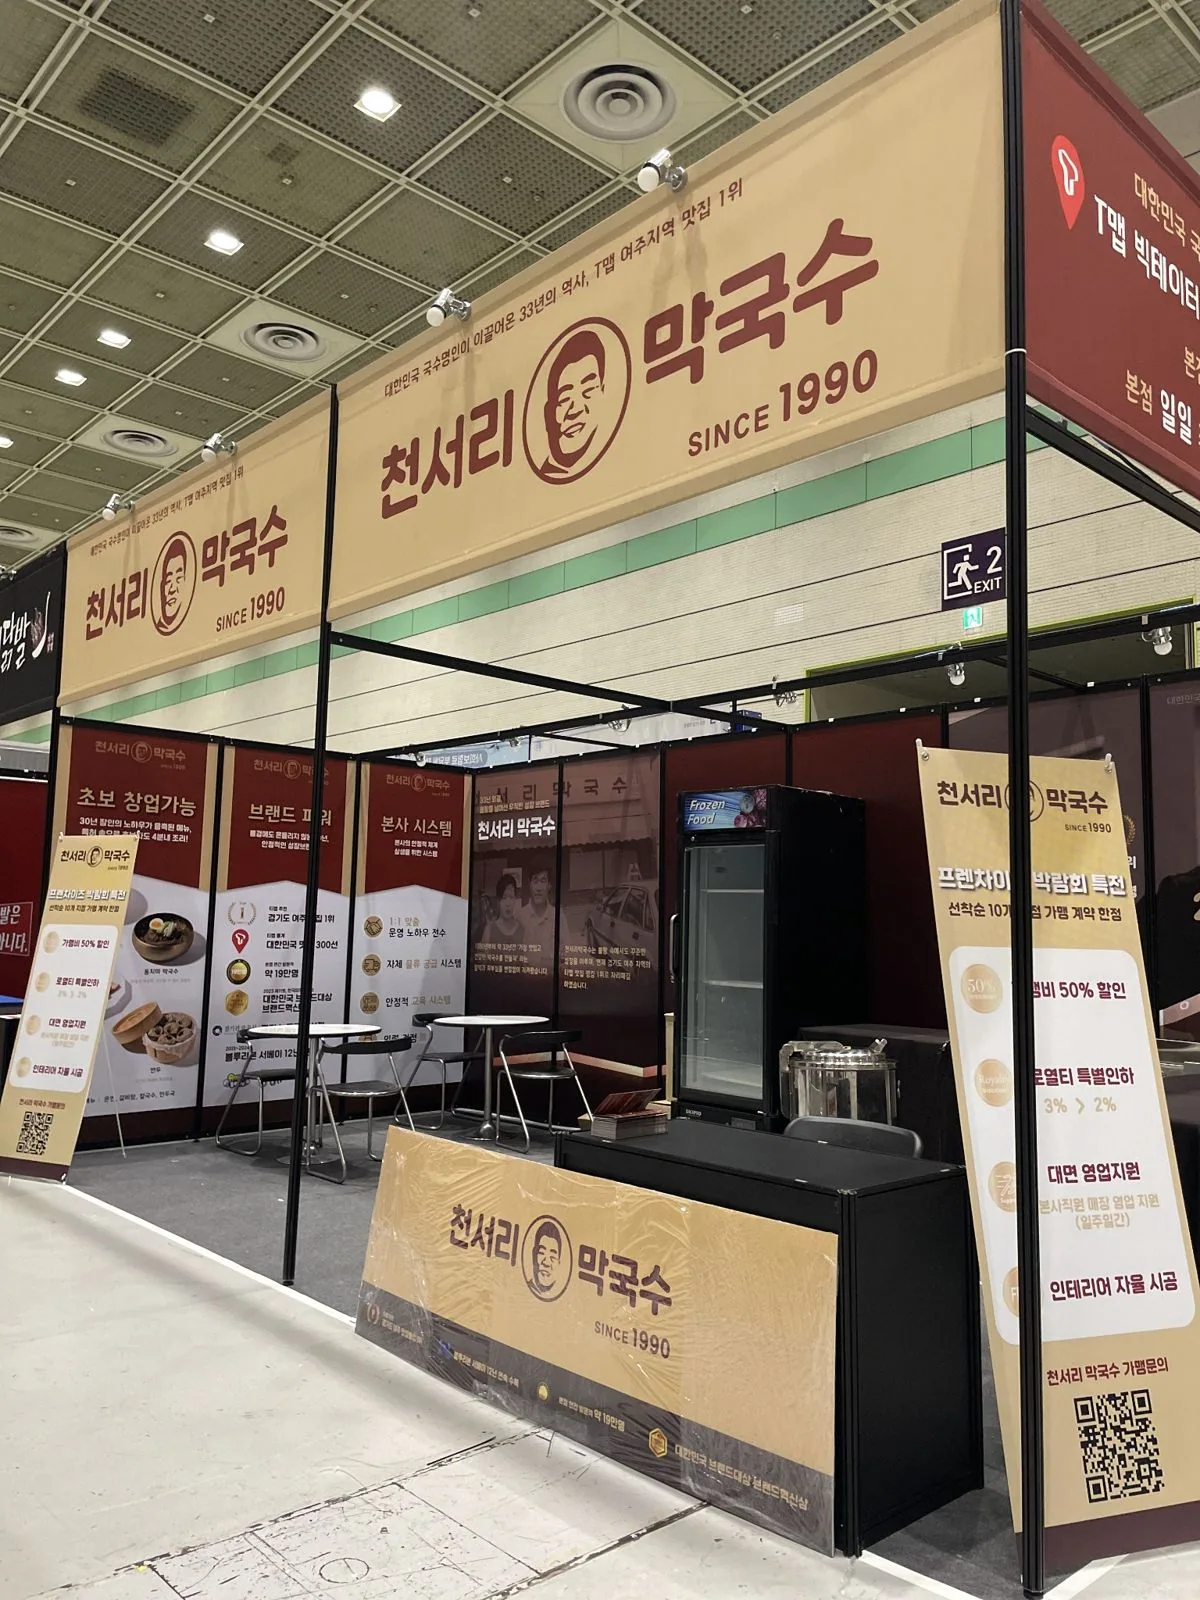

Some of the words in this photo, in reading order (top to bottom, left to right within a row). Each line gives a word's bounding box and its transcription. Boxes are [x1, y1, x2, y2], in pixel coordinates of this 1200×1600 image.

[1134, 172, 1185, 247] 대한민국
[1094, 194, 1126, 259] T맵
[1134, 229, 1200, 320] 빅데이터
[384, 368, 420, 398] 대한민국
[422, 343, 471, 379] 국수명인이
[472, 313, 515, 346] 이끌어온
[520, 289, 557, 323] 33년의
[560, 271, 590, 296] 역사,
[594, 252, 616, 280] T맵
[620, 217, 676, 262] 여주지역
[681, 193, 711, 231] 맛집
[718, 178, 745, 208] 1위
[381, 390, 514, 519] 천서리
[644, 218, 879, 385] 막국수
[687, 404, 770, 457] SINCE
[779, 349, 878, 422] 1990
[1125, 369, 1153, 416] 본점
[1160, 389, 1192, 446] 일일
[986, 545, 1002, 574] 2
[86, 567, 148, 641] 천서리
[202, 504, 289, 588] 막국수
[974, 576, 1002, 594] EXIT
[216, 608, 247, 632] SINCE
[250, 586, 285, 621] 1990
[154, 747, 186, 761] 막국수
[77, 787, 116, 808] 초보
[124, 791, 196, 817] 창업가능
[689, 798, 726, 811] Frozen
[937, 780, 1002, 809] 천서리
[1046, 788, 1108, 814] 막국수
[248, 803, 296, 823] 브랜드
[687, 812, 716, 825] Food
[80, 817, 98, 826] 30년
[123, 820, 153, 830] 노하우가
[381, 816, 409, 833] 본사
[414, 819, 452, 837] 시스템
[478, 819, 514, 840] 천서리
[517, 815, 556, 838] 막국수
[1065, 823, 1088, 832] SINCE
[1088, 822, 1111, 833] 1990
[172, 834, 189, 844] 조리!
[60, 850, 87, 862] 천서리
[104, 850, 130, 862] 막국수
[1032, 871, 1088, 894] 박람회
[1091, 873, 1126, 896] 특전
[268, 913, 290, 923] 경기도
[324, 914, 335, 923] 1위
[949, 901, 986, 918] 선착순
[1044, 905, 1068, 920] 가맹
[1073, 906, 1095, 921] 계약
[1100, 907, 1121, 921] 한정
[389, 928, 404, 938] 운영
[406, 928, 429, 938] 노하우
[432, 928, 446, 938] 전수
[81, 939, 95, 948] 50%
[266, 940, 297, 949] 대한민국
[315, 940, 338, 950] 300선
[265, 969, 273, 978] 약
[275, 969, 299, 978] 19만명
[386, 959, 403, 969] 자체
[440, 959, 461, 969] 시스템
[262, 994, 294, 1004] 대한민국
[1060, 981, 1094, 998] 50%
[1097, 982, 1127, 999] 할인
[386, 997, 409, 1008] 안정적
[259, 1049, 282, 1060] 서베이
[1077, 1067, 1134, 1086] 특별인하
[1044, 1098, 1068, 1113] 3%
[1094, 1096, 1117, 1113] 2%
[1047, 1163, 1078, 1184] 대면
[1081, 1162, 1140, 1183] 영업지원
[1112, 1195, 1135, 1210] 영업
[1138, 1193, 1160, 1208] 지원
[1075, 1213, 1130, 1231] (일주일간)
[449, 1203, 519, 1266] 천서리
[578, 1243, 672, 1316] 막국수
[1050, 1277, 1112, 1301] 인테리어
[1116, 1273, 1145, 1295] 자율
[1149, 1271, 1178, 1291] 시공
[594, 1320, 629, 1345] SINCE
[632, 1328, 670, 1359] 1990
[1046, 1366, 1083, 1386] 천서리
[1085, 1362, 1120, 1381] 막국수
[1122, 1357, 1169, 1377] 가맹문의
[602, 1412, 625, 1432] 19만명
[674, 1443, 708, 1467] 대한민국
[709, 1458, 751, 1487] 브랜드대상
